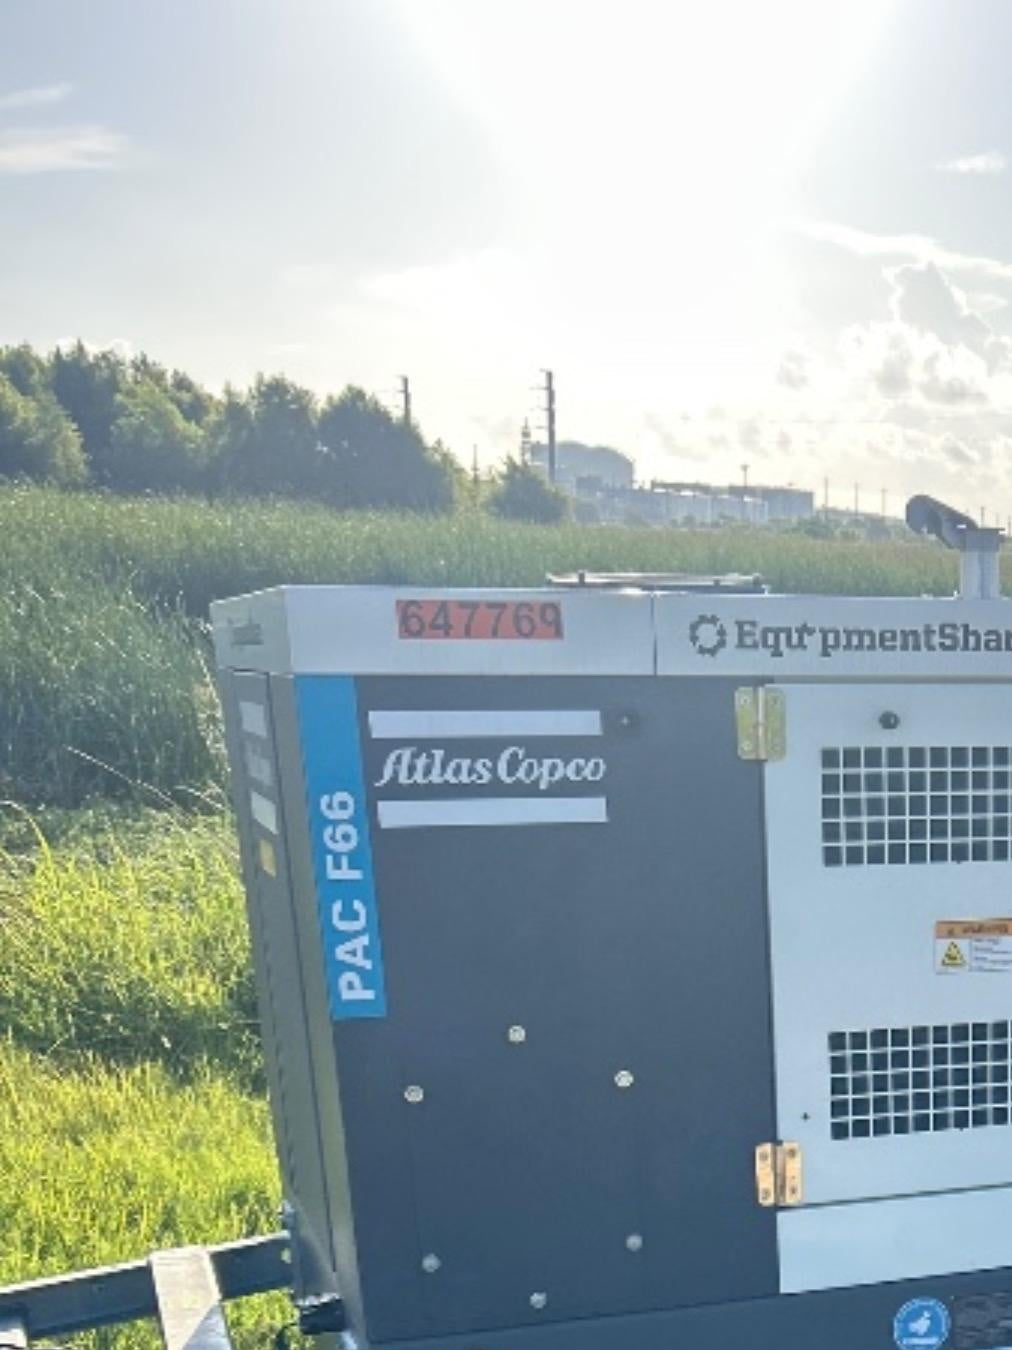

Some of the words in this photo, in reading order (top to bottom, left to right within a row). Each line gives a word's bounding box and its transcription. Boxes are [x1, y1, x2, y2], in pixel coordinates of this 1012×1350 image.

[401, 600, 564, 639] 647769
[374, 746, 493, 787] Atlas
[497, 746, 608, 790] Copco
[320, 790, 364, 880] F66
[331, 899, 376, 1001] PAC
